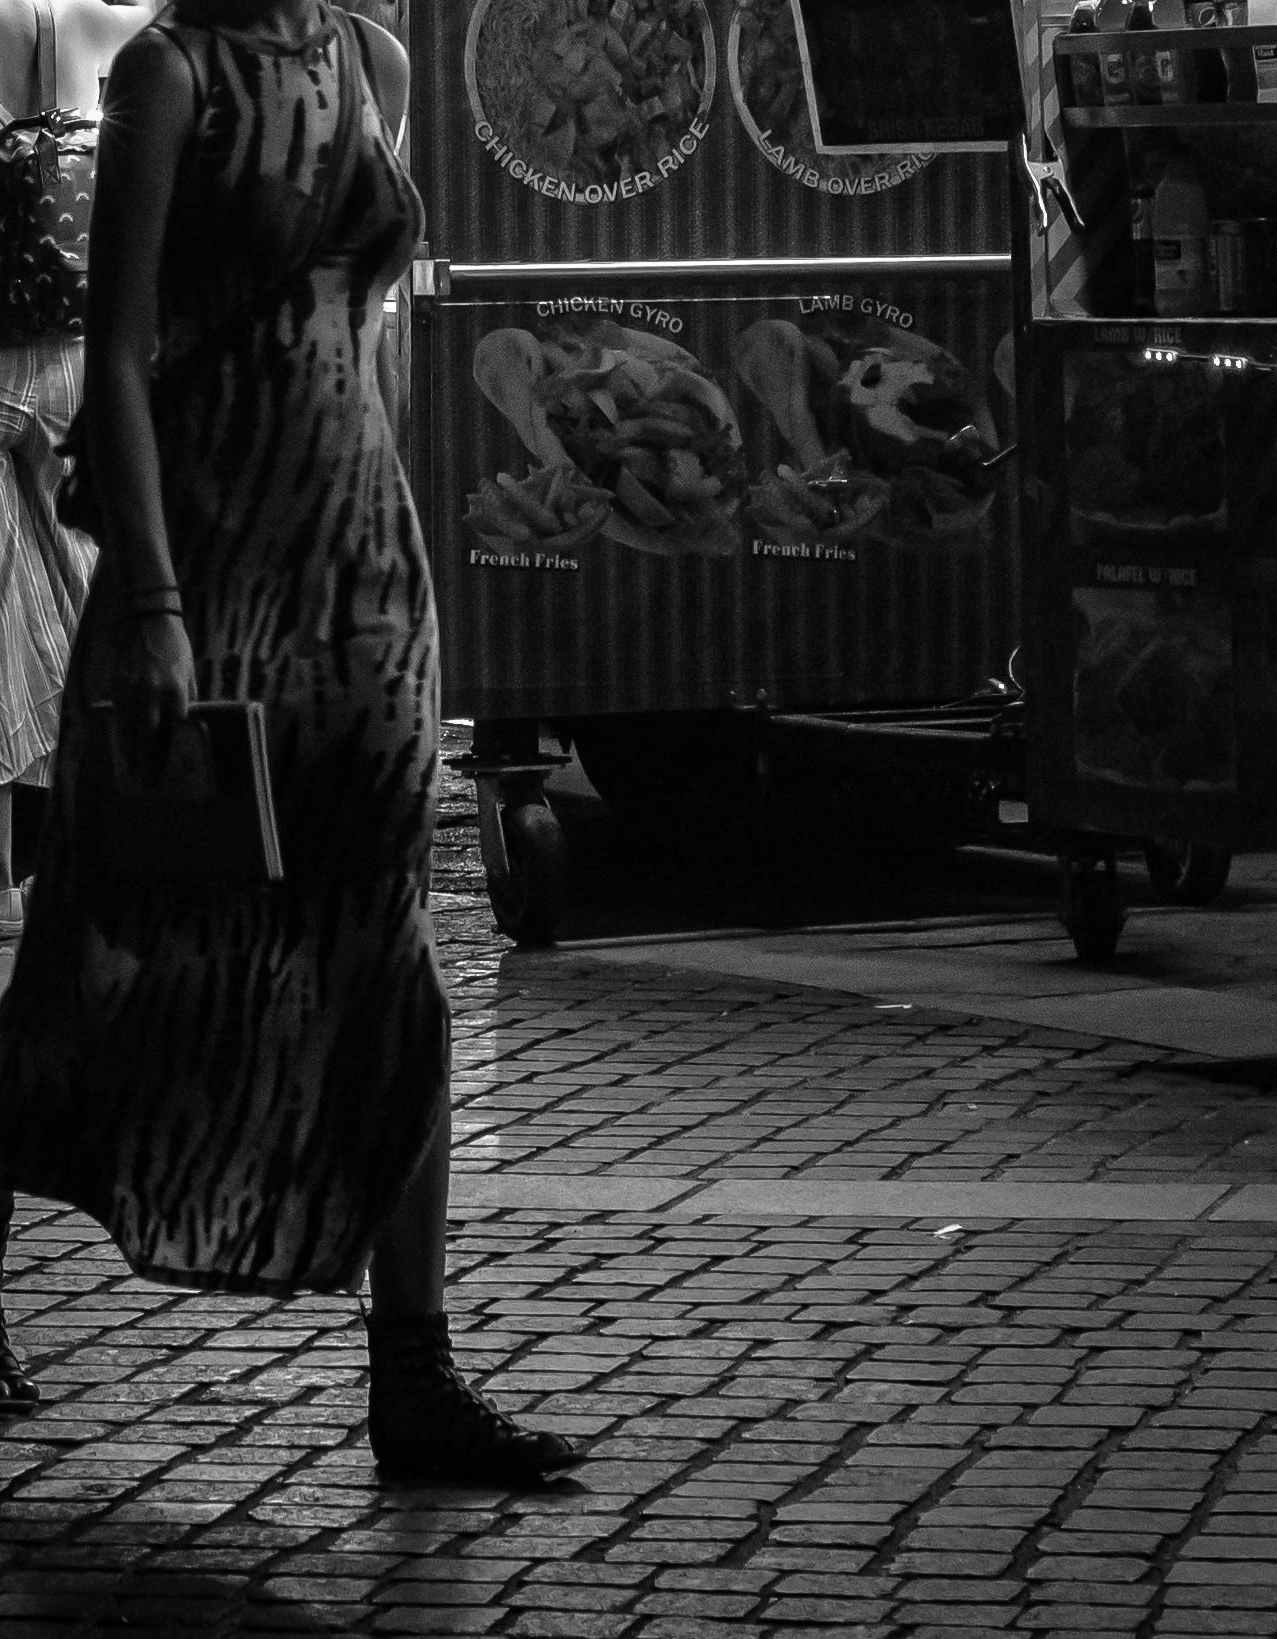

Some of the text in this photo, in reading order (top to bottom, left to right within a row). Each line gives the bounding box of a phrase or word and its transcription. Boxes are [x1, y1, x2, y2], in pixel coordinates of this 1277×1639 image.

[472, 116, 712, 206] CHICKEN OVER RICE
[757, 127, 890, 198] LAMB OVER
[535, 296, 685, 335] CHICKEN GYRO
[797, 295, 915, 330] LAMB GYRO
[468, 549, 580, 573] French Fries
[751, 538, 857, 563] French Fries
